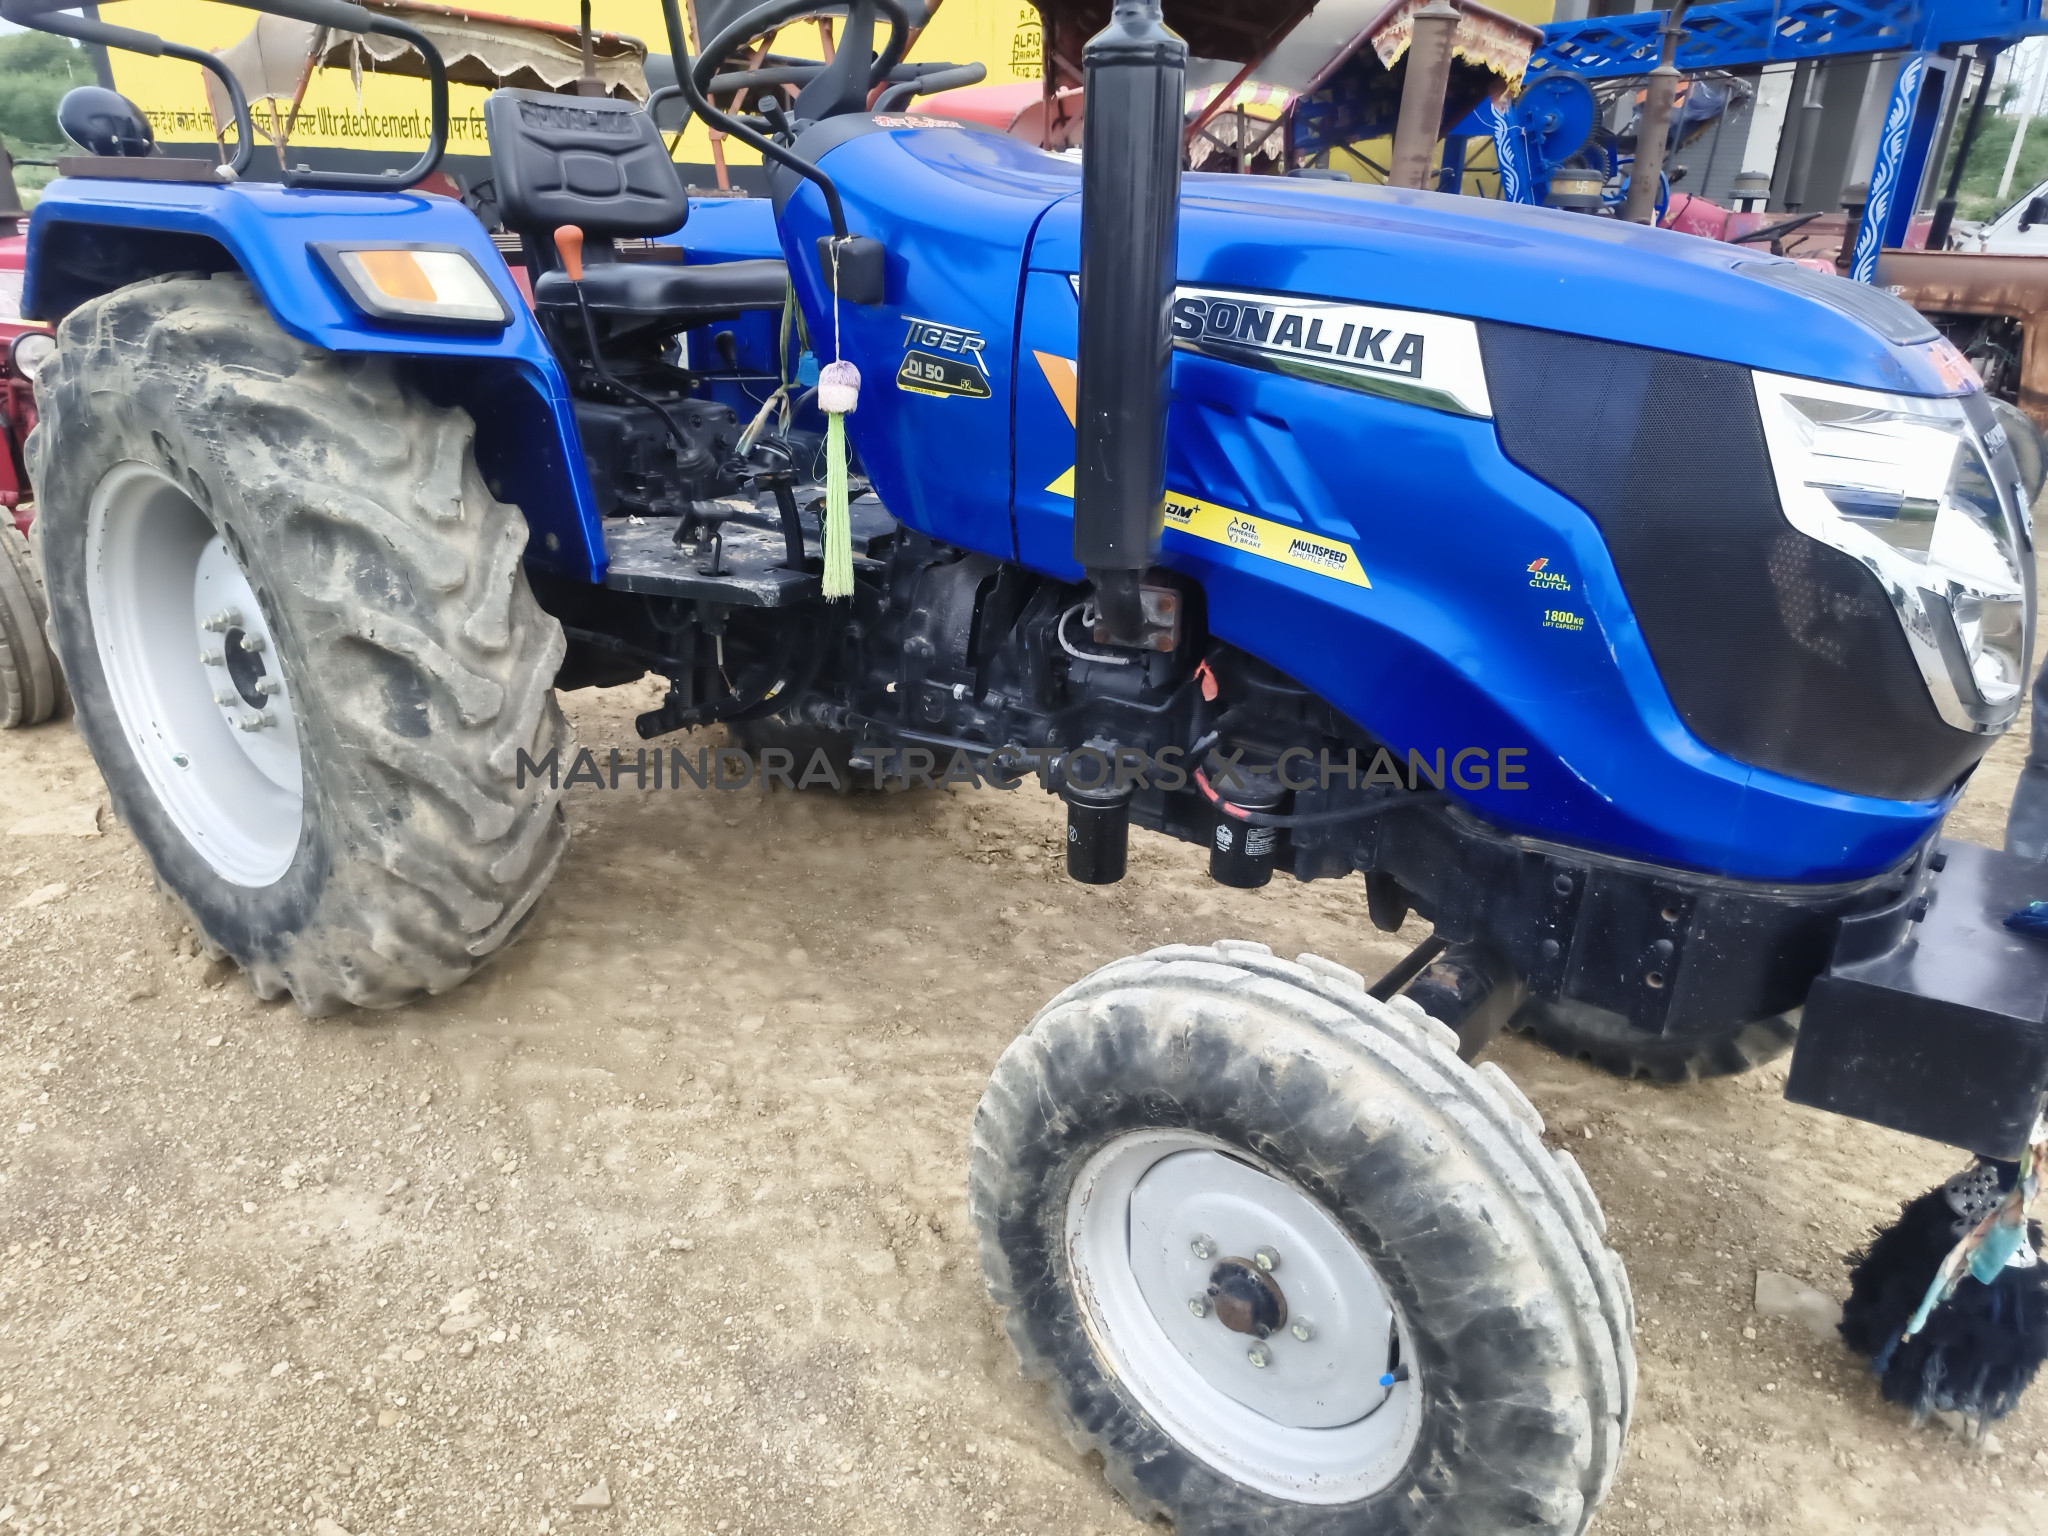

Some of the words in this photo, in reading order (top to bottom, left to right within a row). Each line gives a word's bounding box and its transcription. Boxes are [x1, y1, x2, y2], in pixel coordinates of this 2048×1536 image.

[316, 106, 452, 139] Ultratechcement.c
[900, 313, 990, 377] TIGER
[1173, 298, 1425, 379] SONALIKA
[908, 359, 922, 376] DI
[925, 363, 944, 381] 50
[1164, 502, 1201, 519] DM+
[1229, 526, 1259, 541] IMMERSED
[1241, 521, 1256, 534] OIL
[1239, 537, 1261, 549] BRAKE
[1288, 538, 1348, 563] MULTISPEED
[1291, 550, 1323, 565] SHUTTLE
[1324, 559, 1345, 571] TECH
[1529, 580, 1571, 591] CLUTCH
[1535, 571, 1567, 583] DUAL
[1555, 622, 1582, 632] CAPACITY
